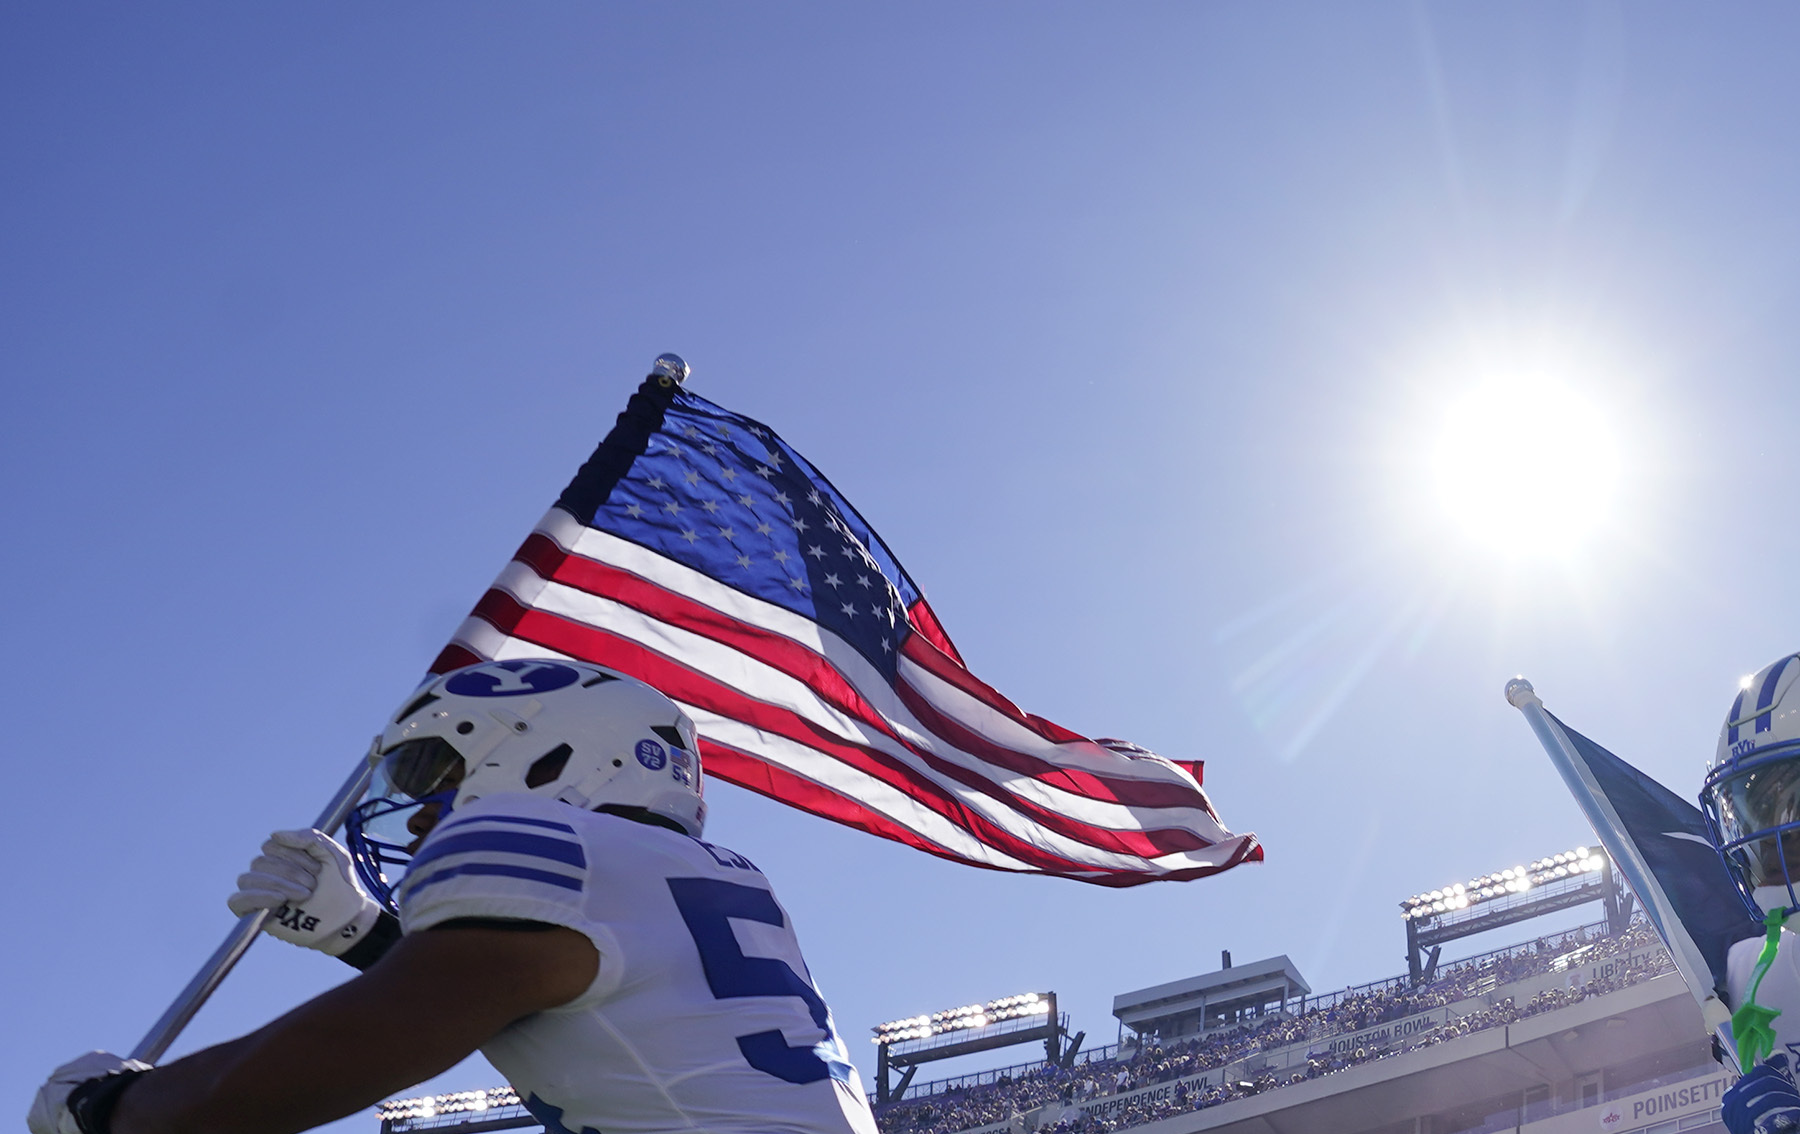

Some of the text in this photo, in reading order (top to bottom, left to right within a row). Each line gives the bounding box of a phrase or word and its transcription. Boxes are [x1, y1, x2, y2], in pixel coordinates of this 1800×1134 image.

[640, 741, 661, 757] SV
[643, 753, 661, 769] 72
[1329, 1016, 1430, 1054] HOUSTON BOWL
[1080, 1086, 1171, 1117] NDEPENDENCE
